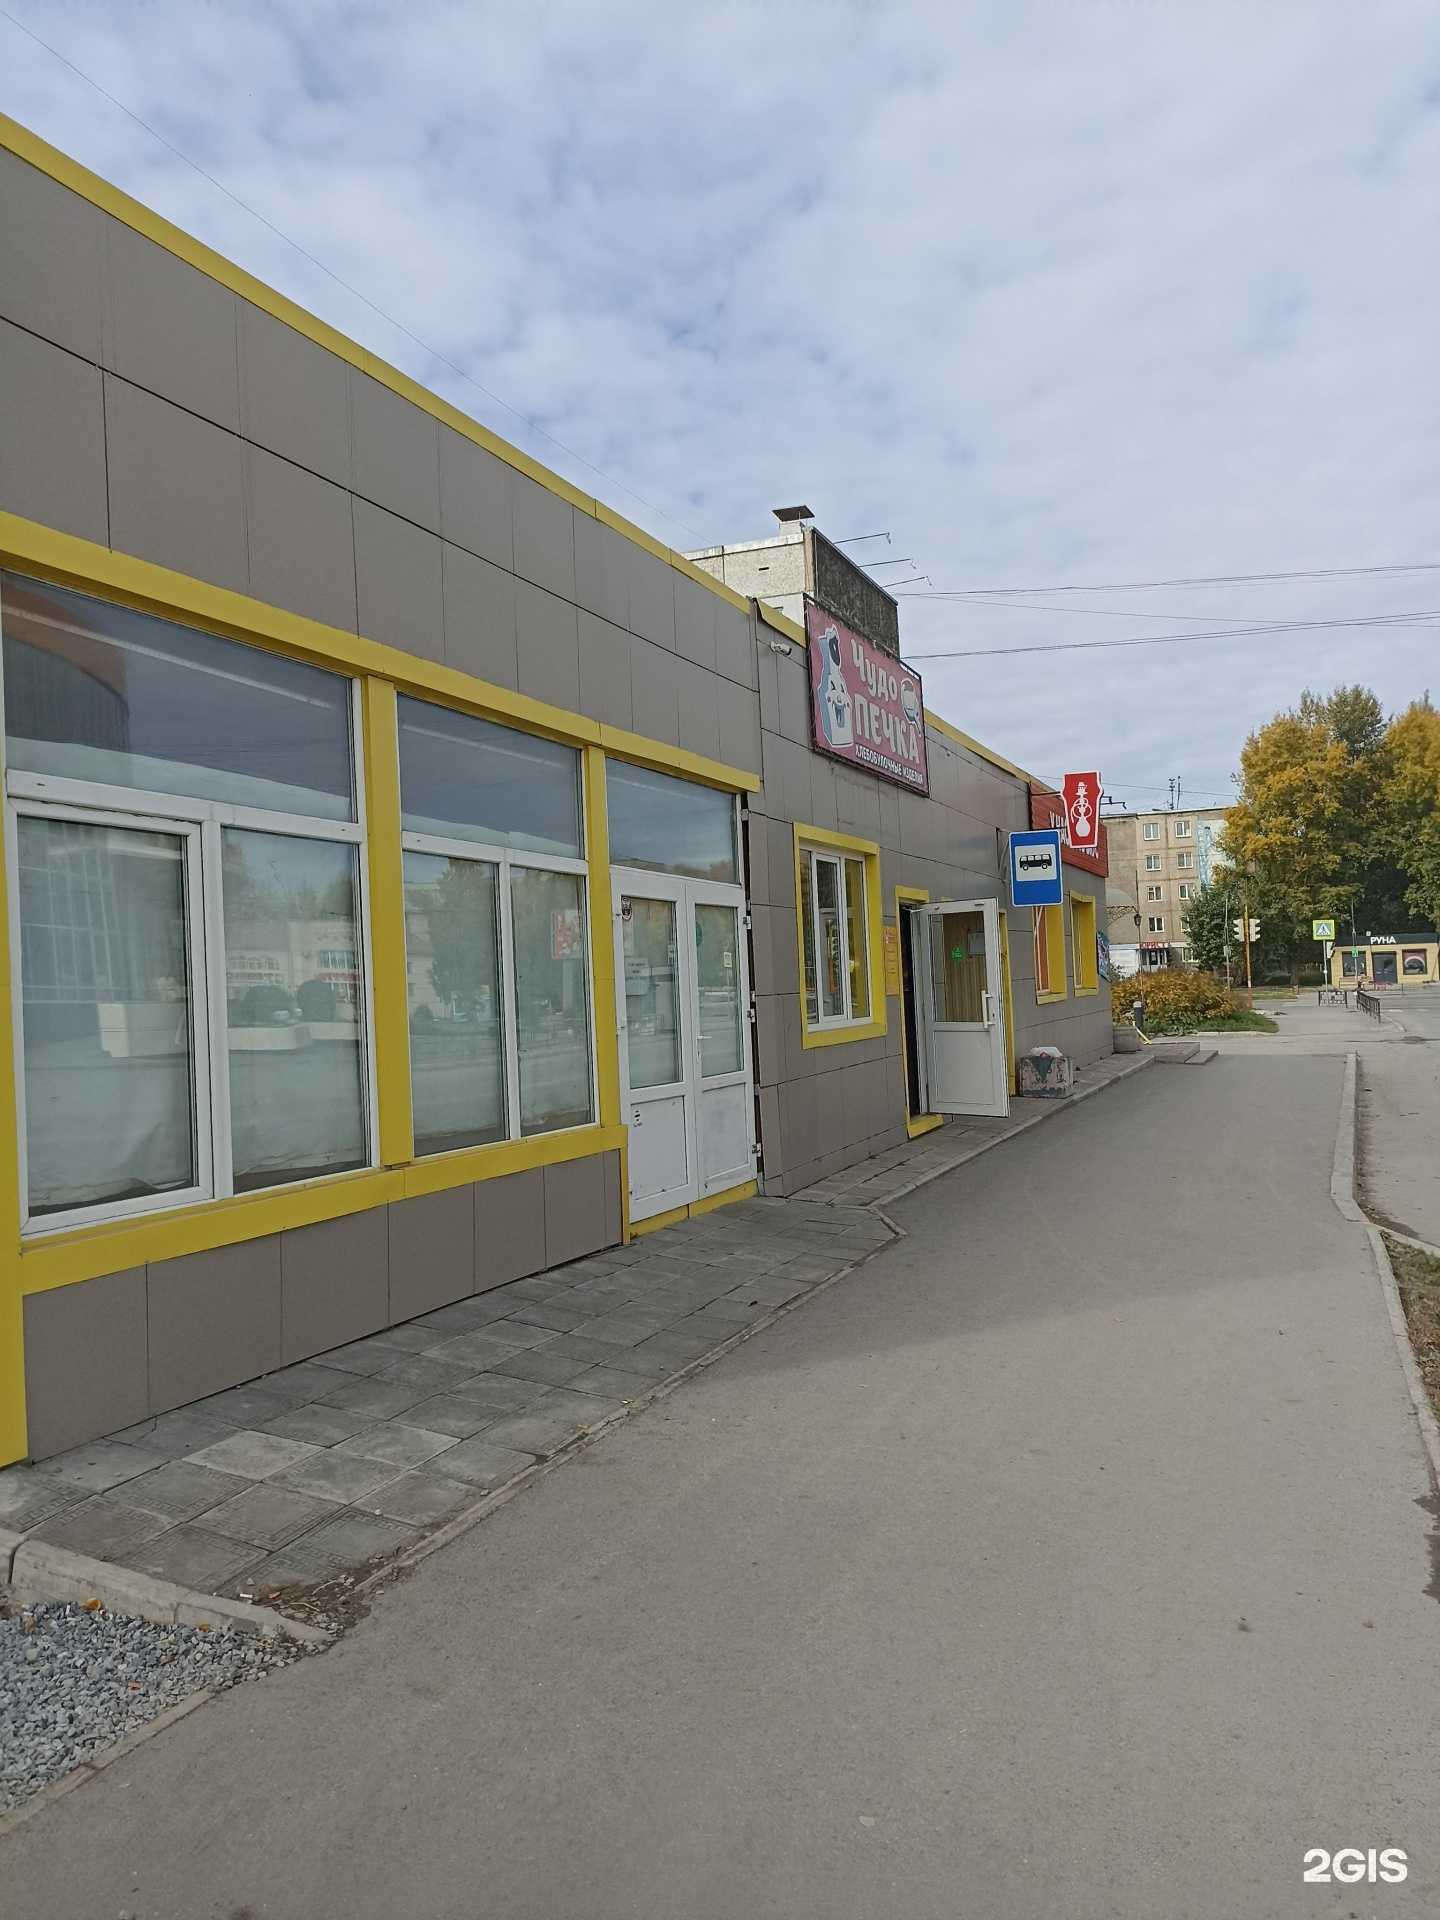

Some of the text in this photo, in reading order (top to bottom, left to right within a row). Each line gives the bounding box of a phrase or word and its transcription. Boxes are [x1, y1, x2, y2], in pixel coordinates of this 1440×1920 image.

[851, 638, 898, 701] ЧУДО
[855, 693, 920, 764] ПЕЧКА
[1370, 936, 1396, 944] РУНА
